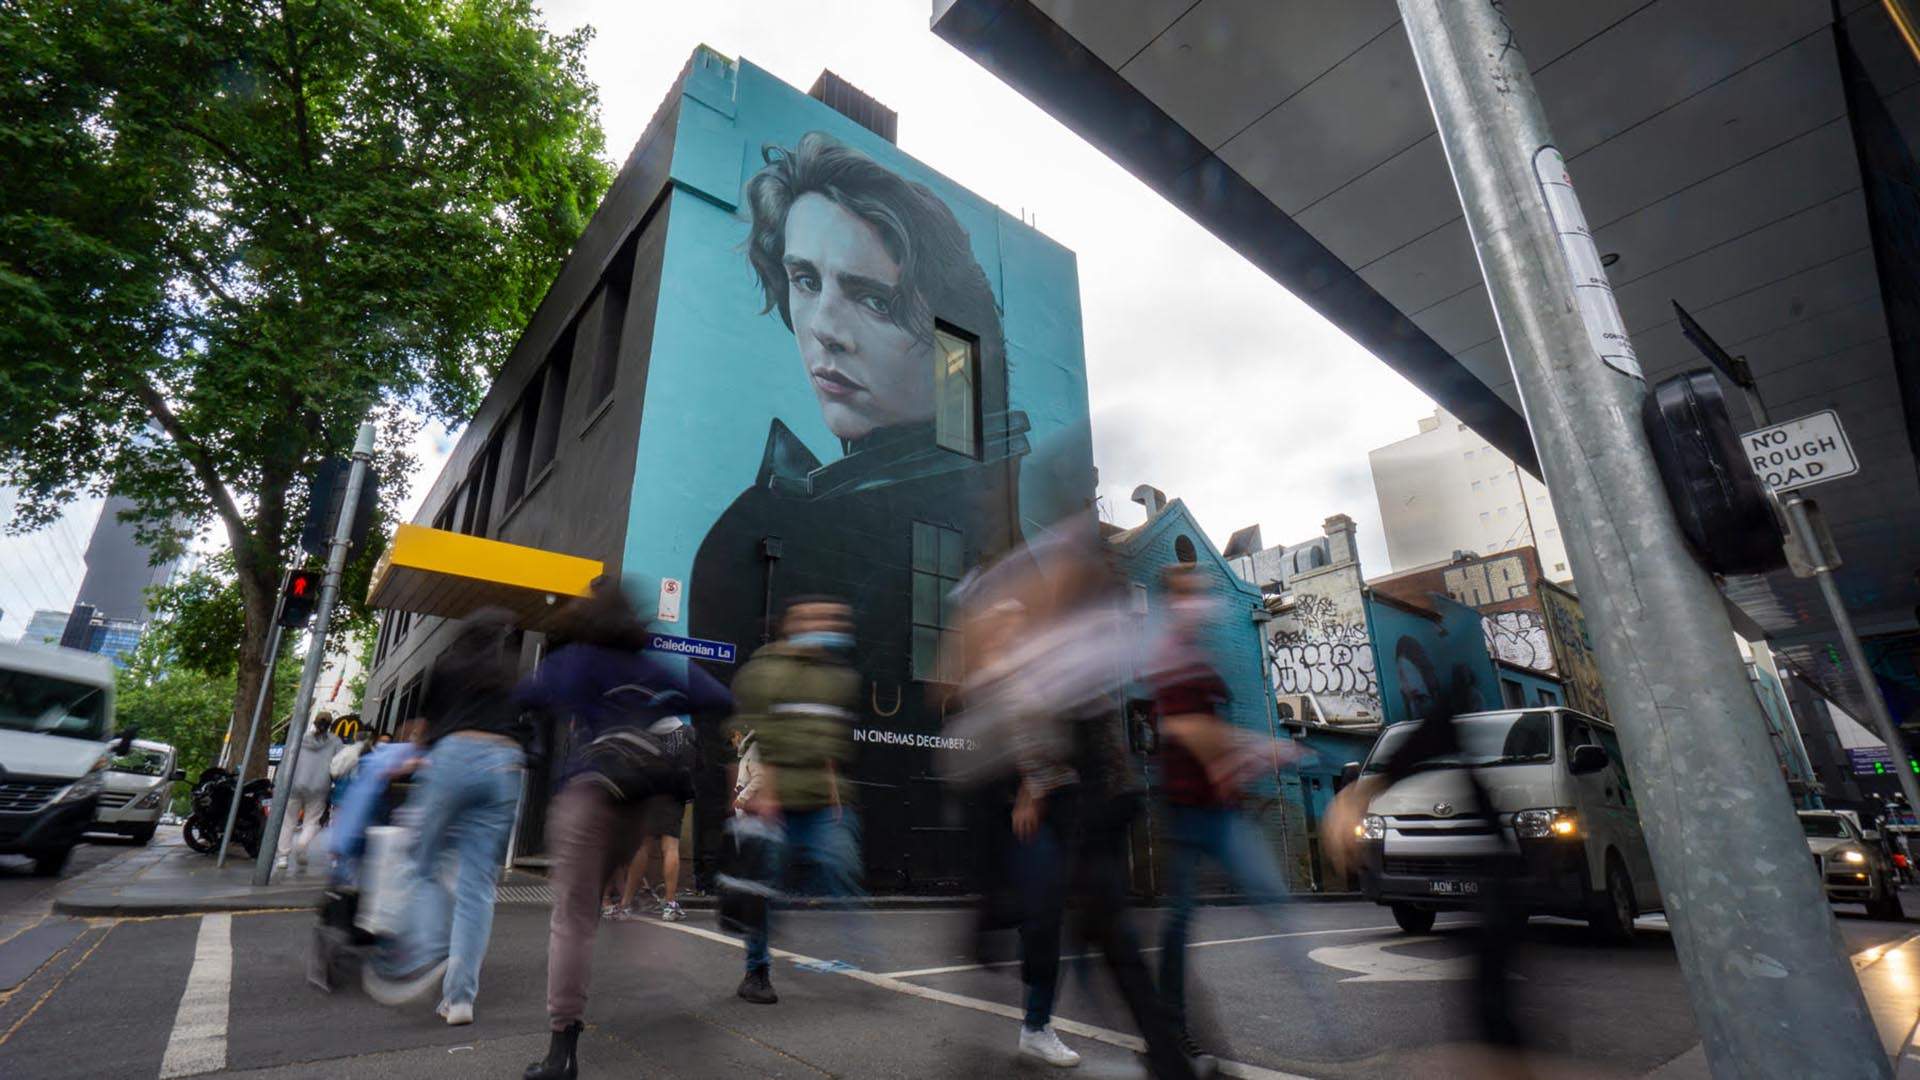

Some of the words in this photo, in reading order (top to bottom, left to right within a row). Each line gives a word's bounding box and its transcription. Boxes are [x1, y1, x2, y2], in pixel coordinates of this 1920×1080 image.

[1751, 430, 1788, 451] NO
[1753, 436, 1837, 471] ROUGH
[1765, 462, 1824, 487] OAD
[653, 637, 714, 656] Caledonian
[718, 646, 731, 658] La
[853, 729, 866, 742] IN
[868, 730, 915, 746] CINEMAS
[916, 734, 964, 750] DECEMBER
